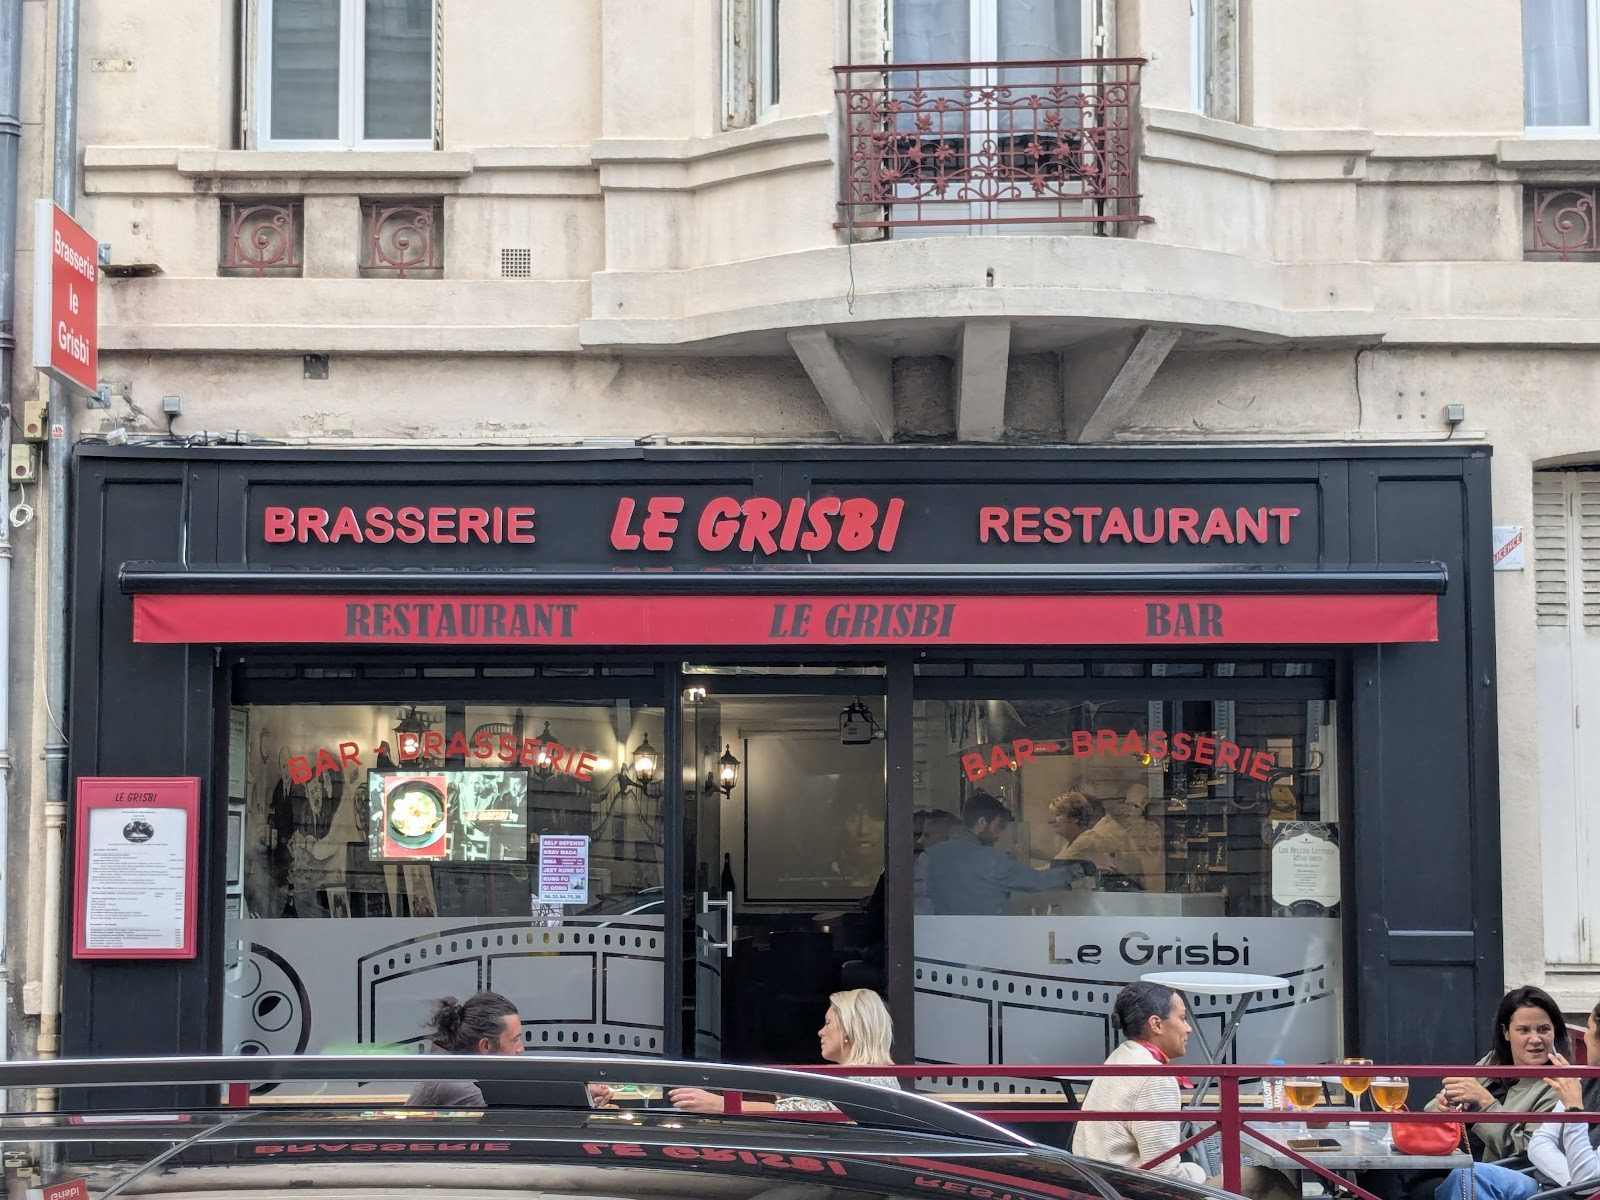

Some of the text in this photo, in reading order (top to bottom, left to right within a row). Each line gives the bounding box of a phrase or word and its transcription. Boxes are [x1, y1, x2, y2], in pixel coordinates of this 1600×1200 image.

[53, 229, 95, 283] Brasserie
[69, 283, 79, 315] le
[58, 320, 90, 366] Grisbi
[264, 506, 536, 544] BRASSERIE
[610, 495, 906, 556] LE GRISBI
[979, 506, 1301, 546] RESTAURANT
[344, 603, 578, 638] RESTAURANT
[768, 603, 957, 638] LE GRISBI
[1145, 603, 1224, 637] BAR
[286, 741, 363, 785] BAR
[398, 730, 598, 782] BRASSERIE
[961, 738, 1041, 782] BAR
[1071, 729, 1276, 782] BRASSERIE
[115, 792, 157, 803] LE GRISBI
[1048, 931, 1250, 966] Le Grisbi
